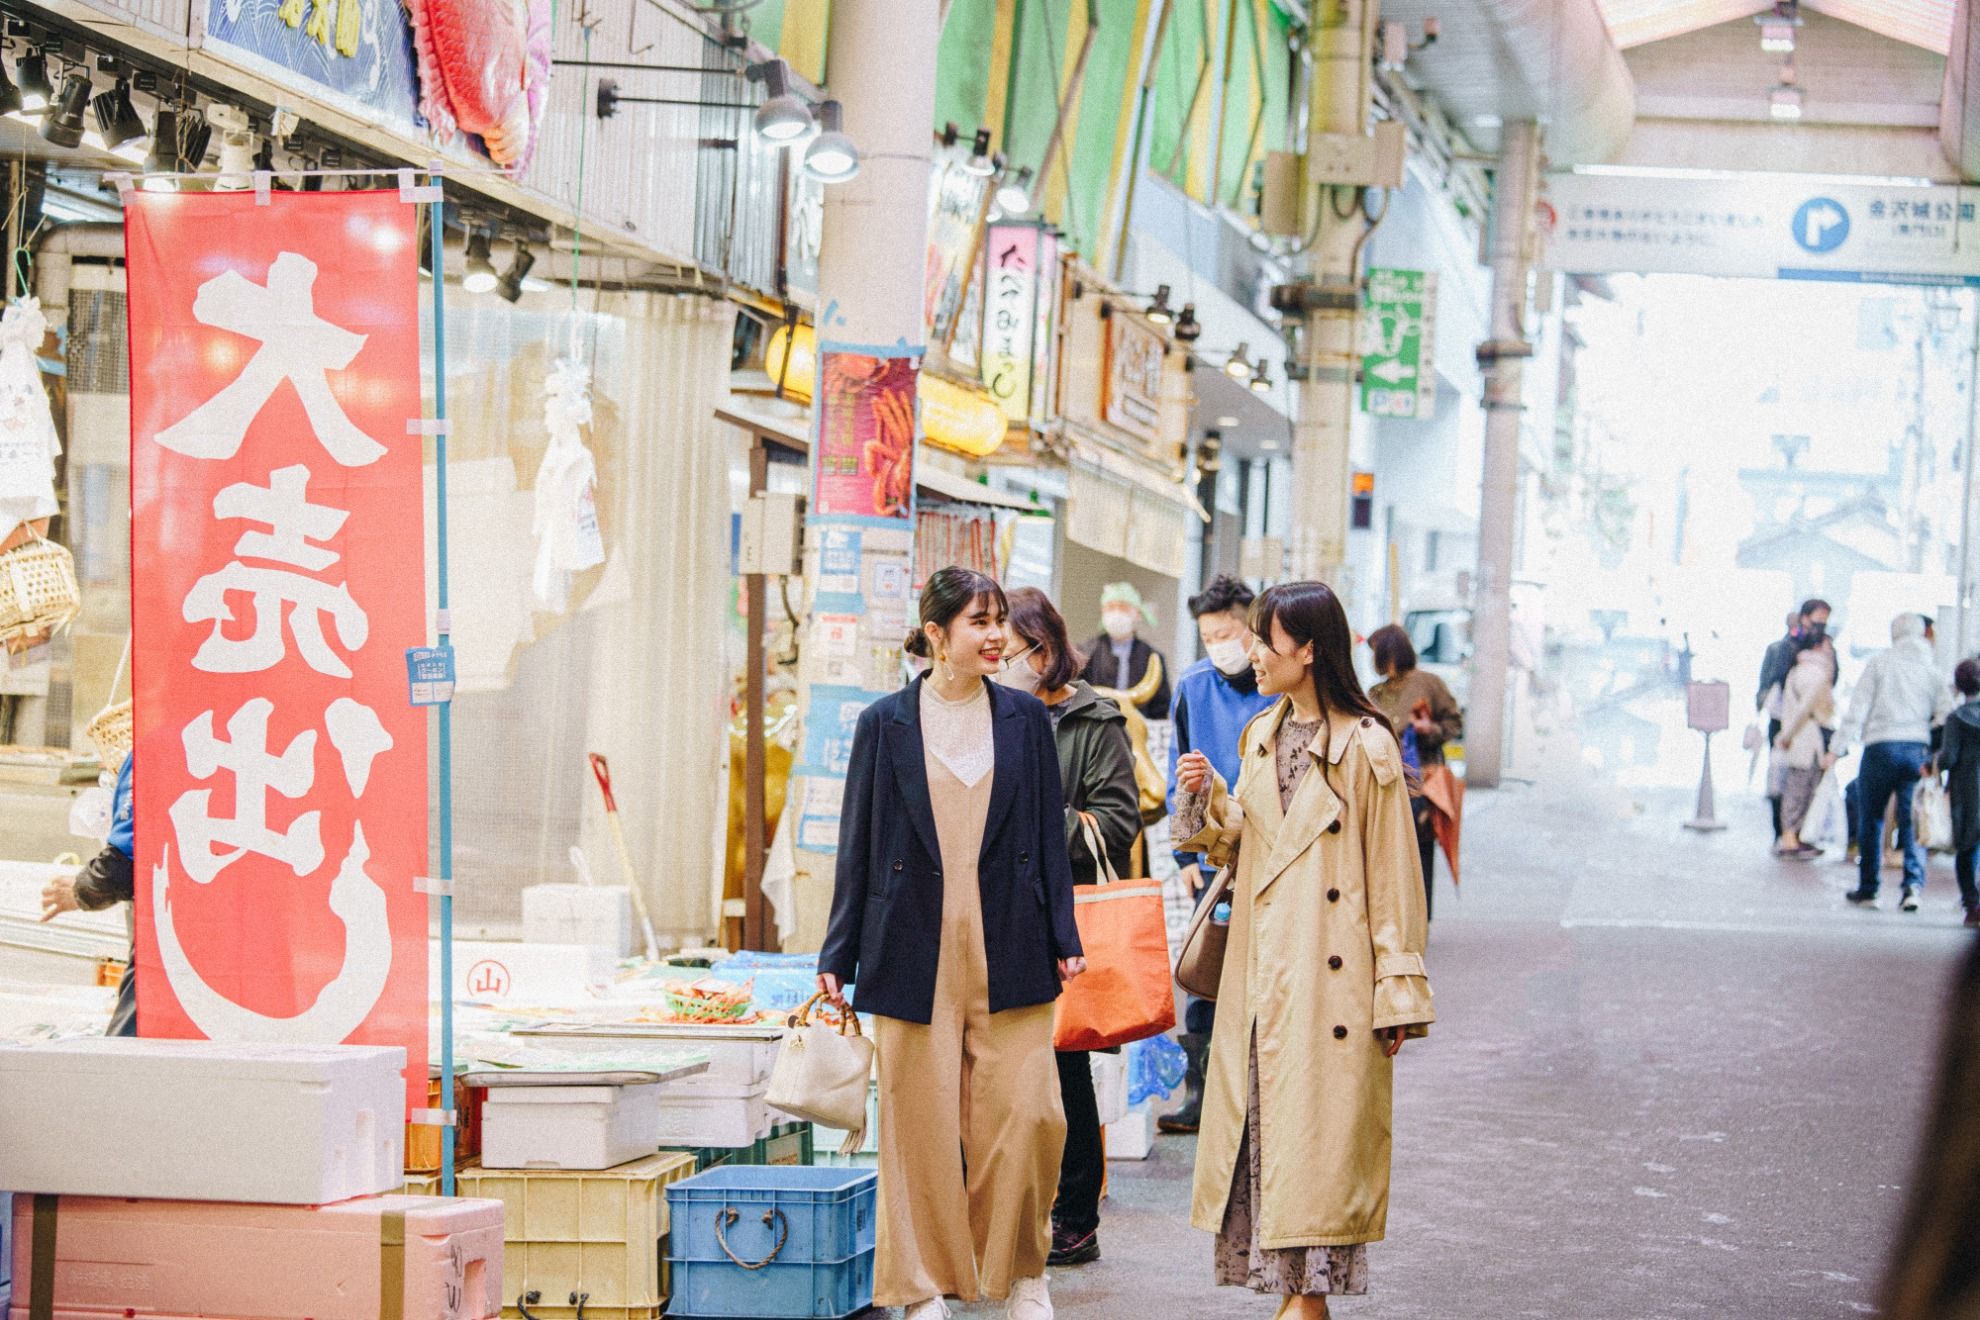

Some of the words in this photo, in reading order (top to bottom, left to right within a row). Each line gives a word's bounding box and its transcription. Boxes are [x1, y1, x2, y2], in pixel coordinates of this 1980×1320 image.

[153, 250, 394, 1043] 大売出し
[474, 965, 503, 993] 山
